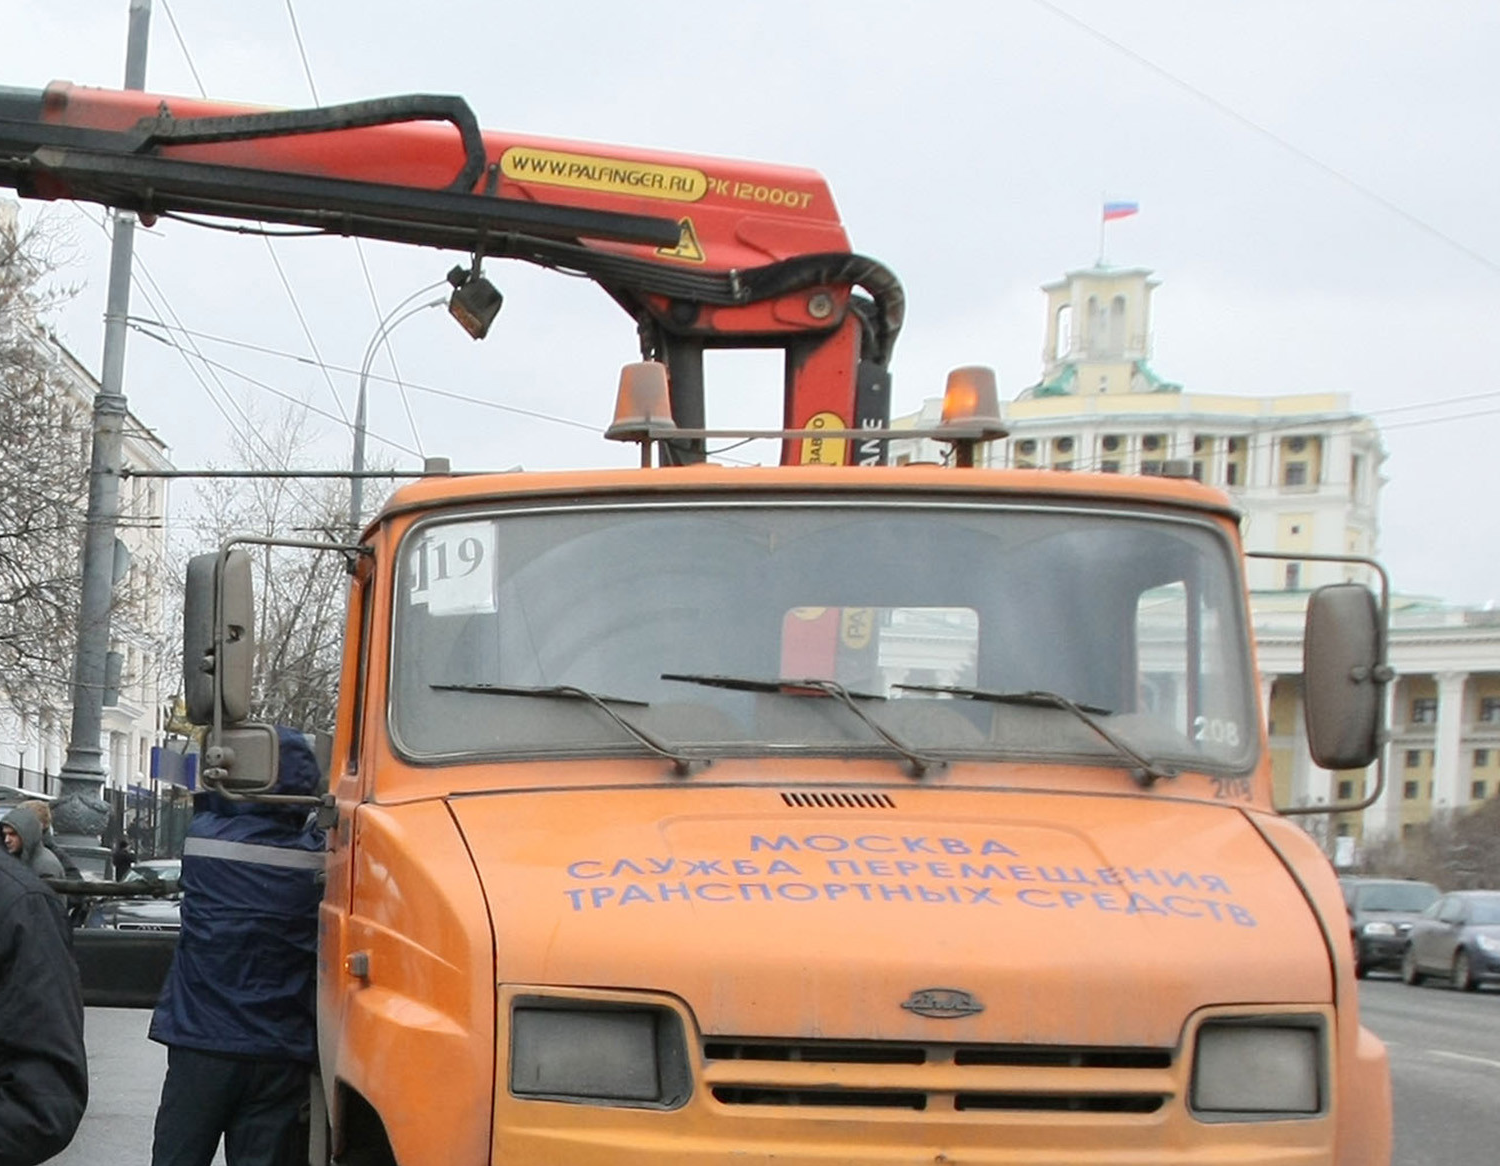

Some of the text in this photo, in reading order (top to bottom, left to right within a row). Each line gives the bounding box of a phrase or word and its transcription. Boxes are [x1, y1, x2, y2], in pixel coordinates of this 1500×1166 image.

[511, 154, 695, 193] WWW.PALFINGER.RU
[733, 182, 813, 208] 12000T
[1193, 715, 1240, 747] 208
[750, 834, 1019, 857] МОСКВА
[566, 857, 1231, 895] СЛУЖБА ПЕРЕМЕЩЕНИЯ
[564, 882, 1258, 928] ТРАНСПОРТНЫХ СРЕДСТВ
